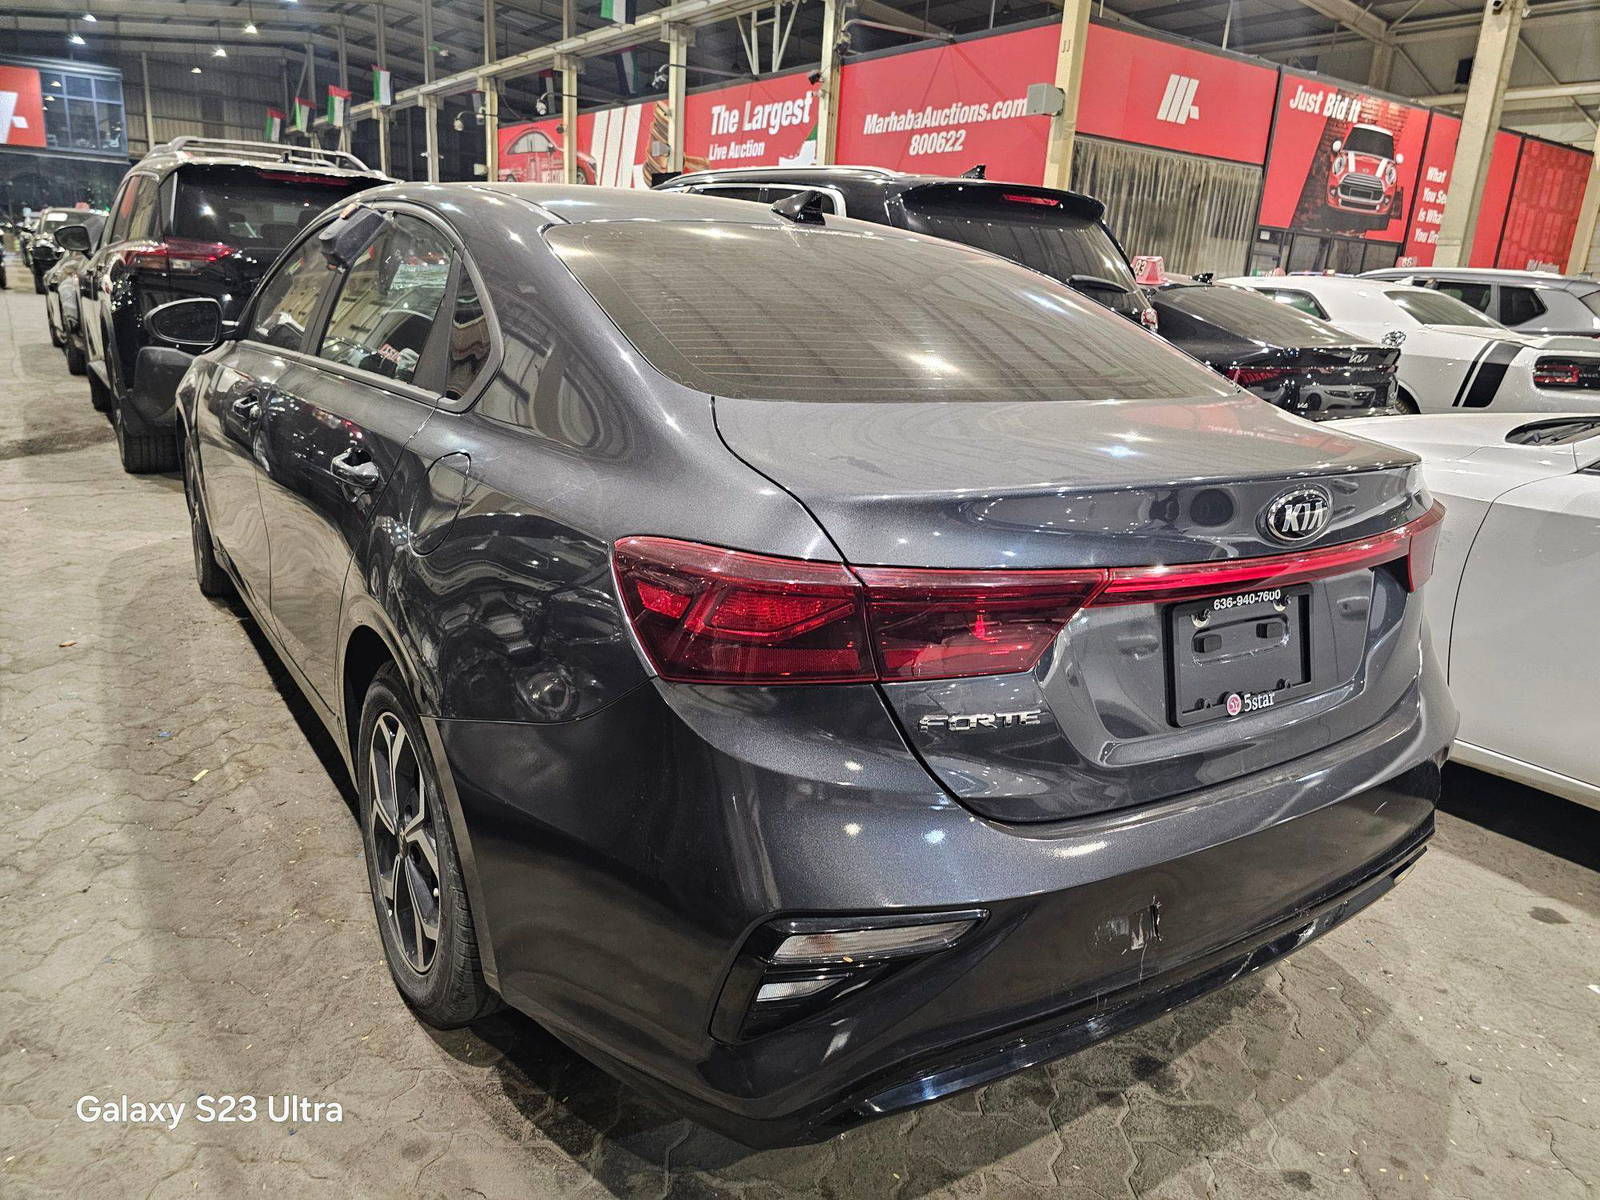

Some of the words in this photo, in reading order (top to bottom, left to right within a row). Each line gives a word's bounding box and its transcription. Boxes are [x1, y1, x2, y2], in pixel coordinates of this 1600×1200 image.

[711, 104, 739, 136] The
[742, 90, 813, 135] Largest
[1289, 84, 1324, 114] Just
[1322, 92, 1350, 121] Bid
[1347, 98, 1362, 123] It
[863, 97, 1028, 135] MarhabaAuctions.com
[708, 143, 728, 161] Live
[727, 140, 766, 159] Auction
[908, 129, 967, 156] 800622
[1426, 165, 1447, 184] What
[1422, 186, 1438, 203] You
[1436, 189, 1448, 205] Se
[1417, 207, 1427, 223] Is
[1425, 208, 1442, 226] Wha
[1413, 227, 1429, 244] You
[1281, 500, 1323, 532] KIA
[1213, 589, 1281, 611] 636-940-7600
[1243, 692, 1276, 712] 5star
[919, 709, 1042, 733] FORTE
